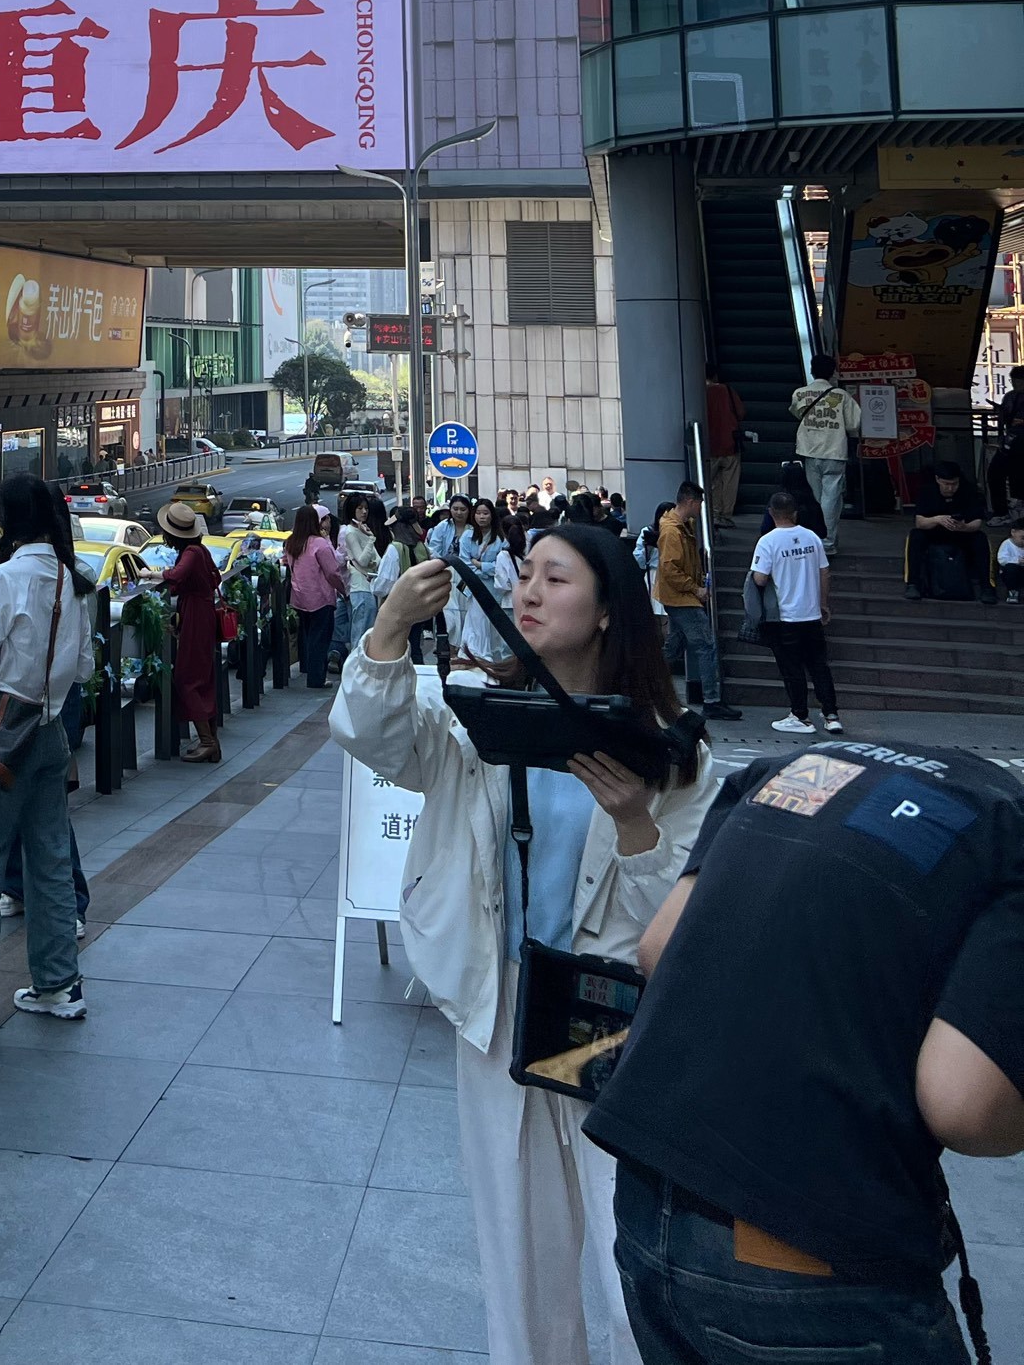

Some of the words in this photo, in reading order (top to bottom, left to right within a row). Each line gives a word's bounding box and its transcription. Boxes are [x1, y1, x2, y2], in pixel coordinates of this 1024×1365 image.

[45, 283, 104, 342] 养出好气色
[446, 428, 457, 445] P
